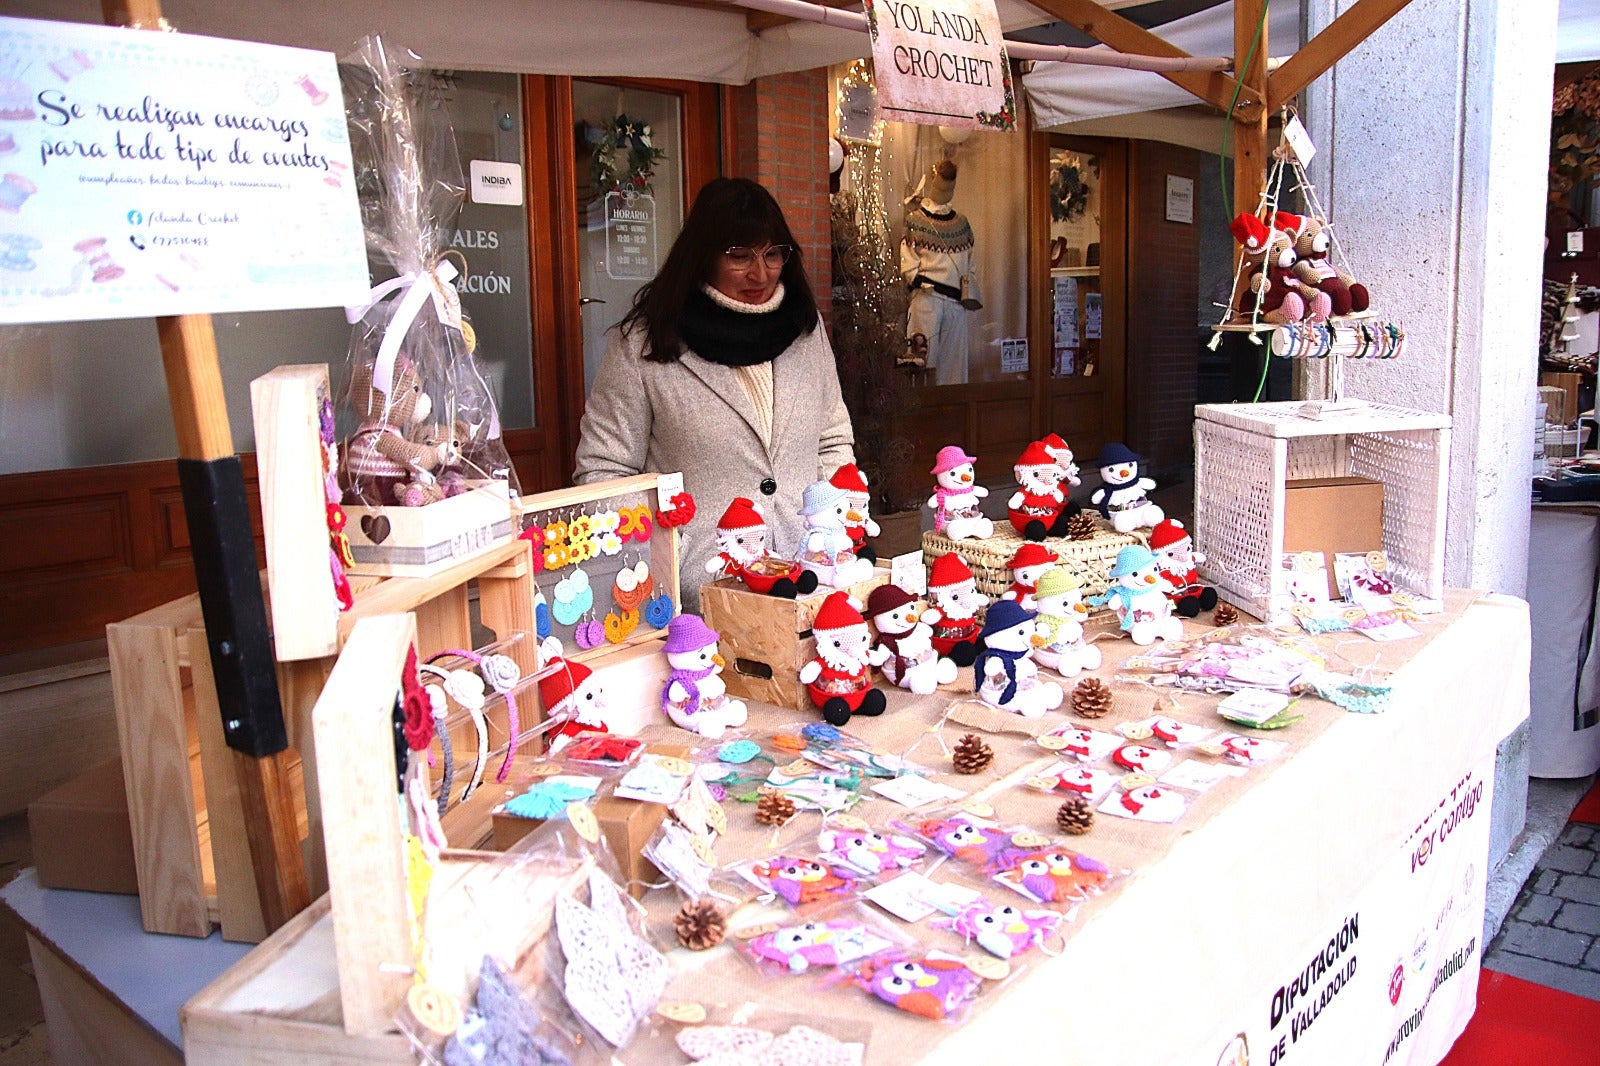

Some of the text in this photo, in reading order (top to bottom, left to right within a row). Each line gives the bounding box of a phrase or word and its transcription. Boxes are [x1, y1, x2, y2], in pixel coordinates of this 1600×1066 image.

[884, 0, 989, 46] YOLANDA
[894, 45, 993, 87] CROCHET
[38, 89, 309, 142] Se realizan encargos
[40, 129, 329, 171] para todo tipo de eventos
[481, 175, 512, 185] INDIBA
[613, 208, 649, 220] HORARIO
[456, 270, 511, 294] ACIÓN
[1412, 828, 1437, 873] ver
[1440, 780, 1483, 842] contigo
[1270, 912, 1359, 1031] DIPUTACIÓN
[1291, 955, 1357, 1044] VALLADOLID
